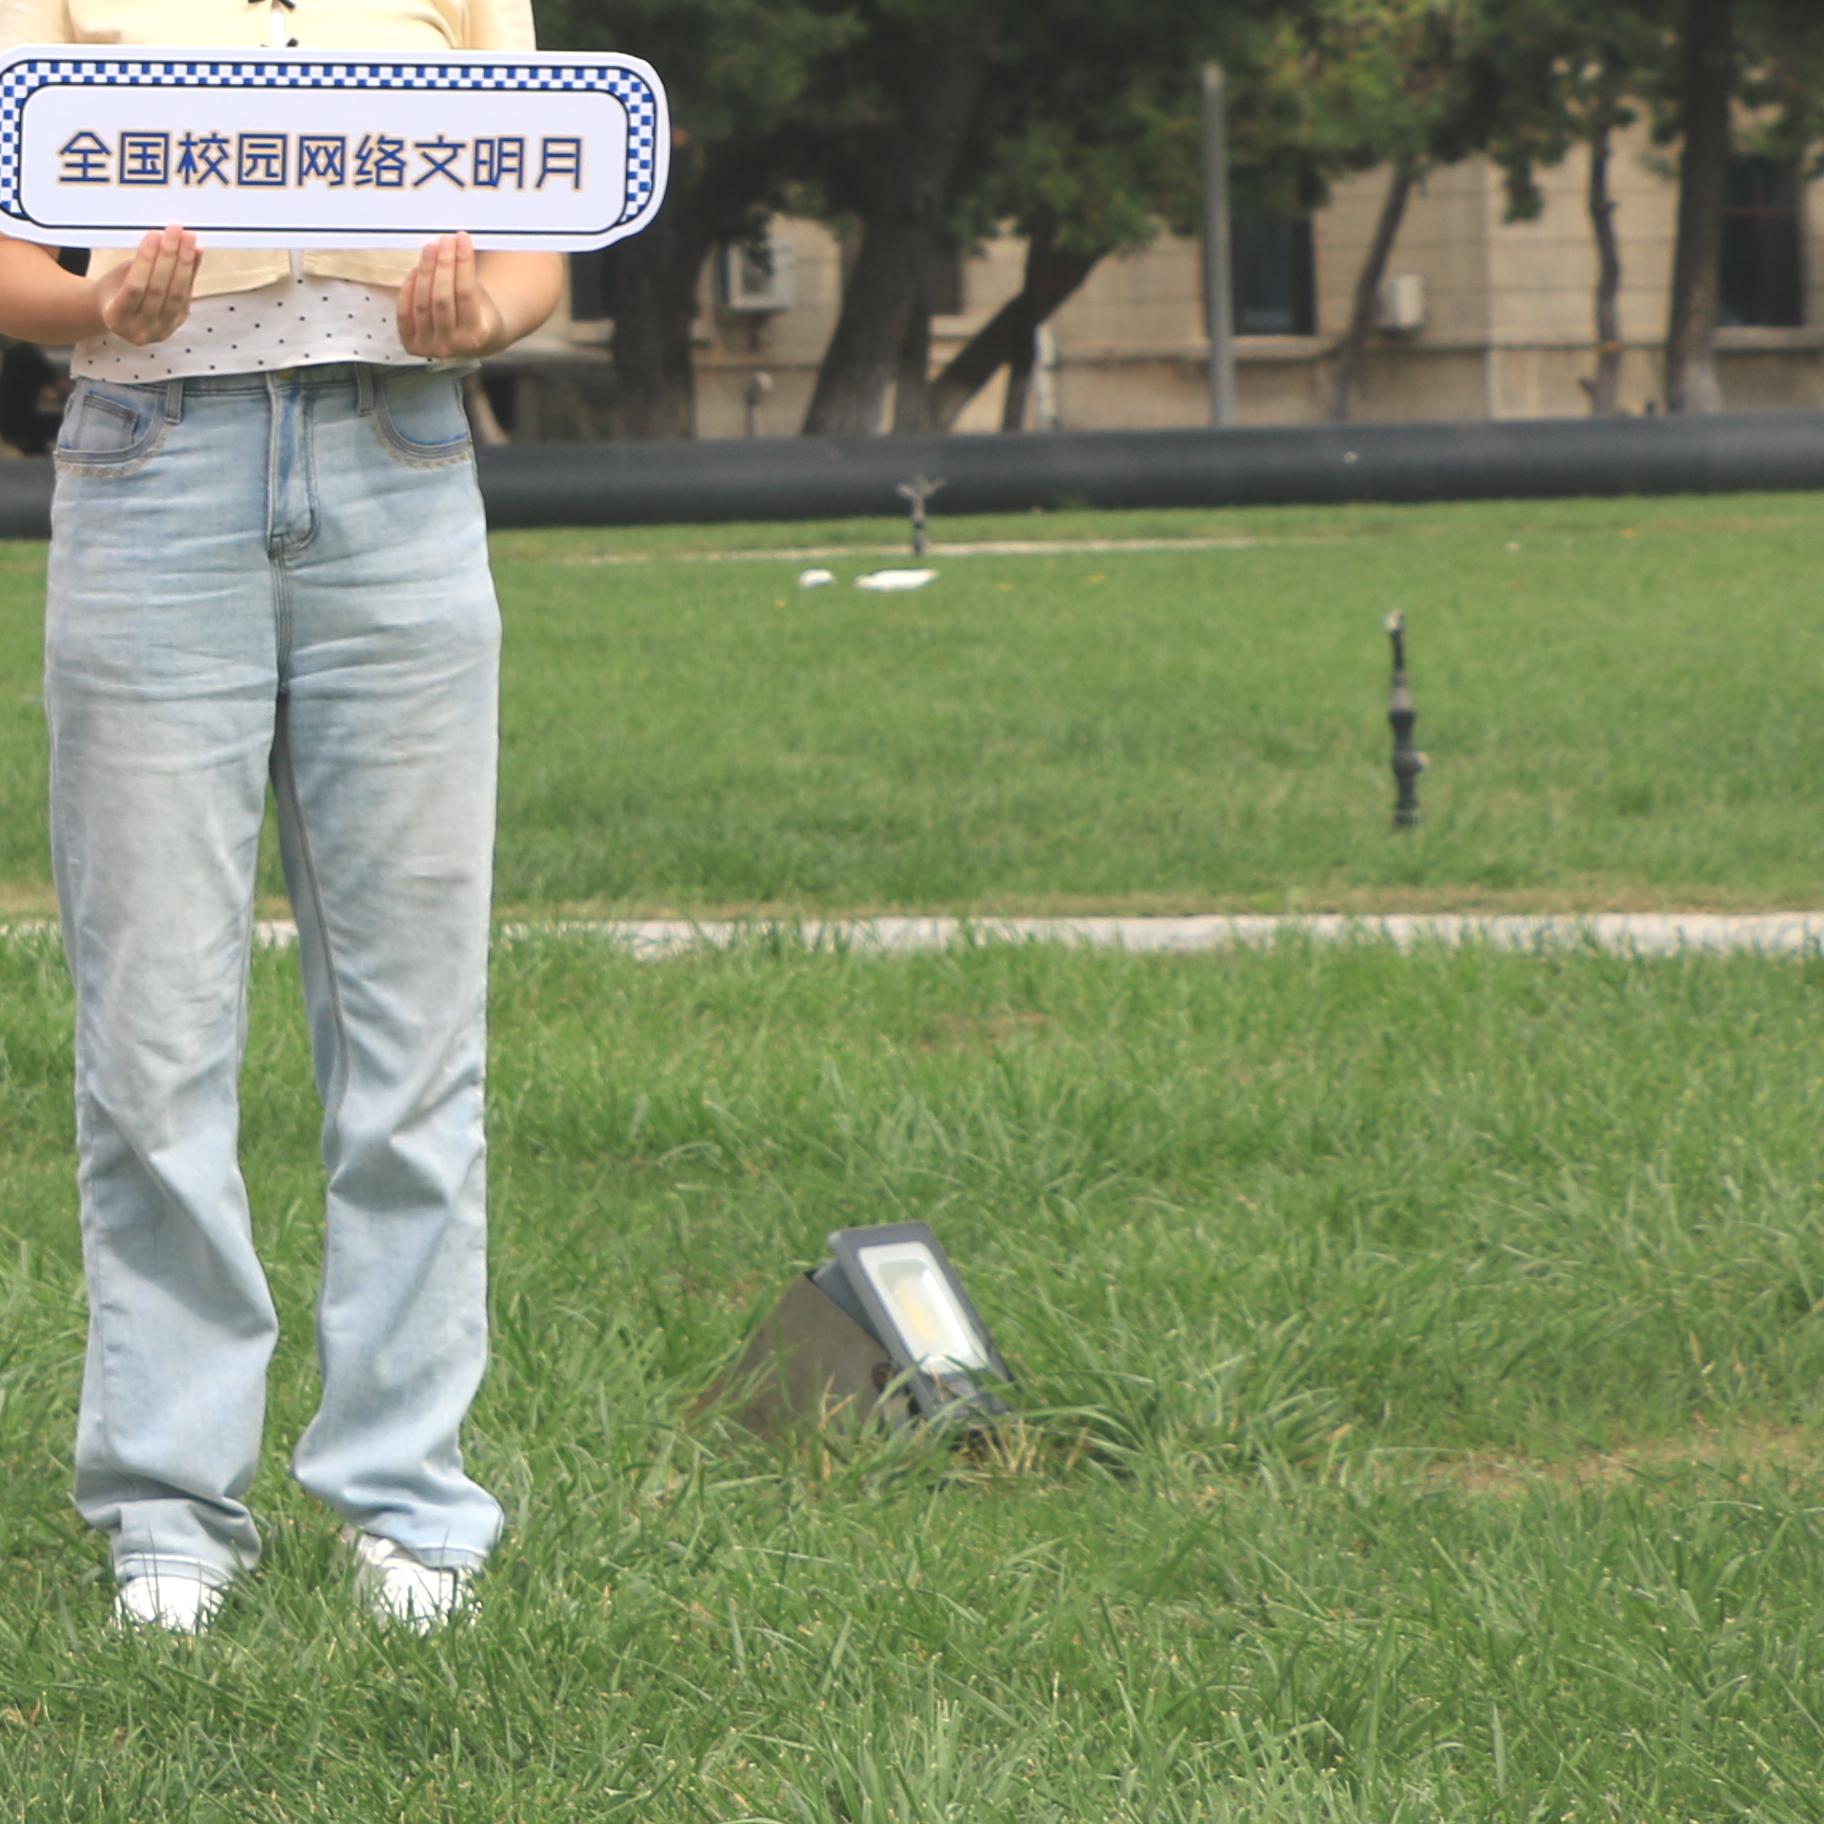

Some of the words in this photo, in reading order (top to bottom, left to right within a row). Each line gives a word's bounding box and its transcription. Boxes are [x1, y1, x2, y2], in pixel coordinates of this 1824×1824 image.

[58, 130, 583, 191] 全国校园网络文明月
